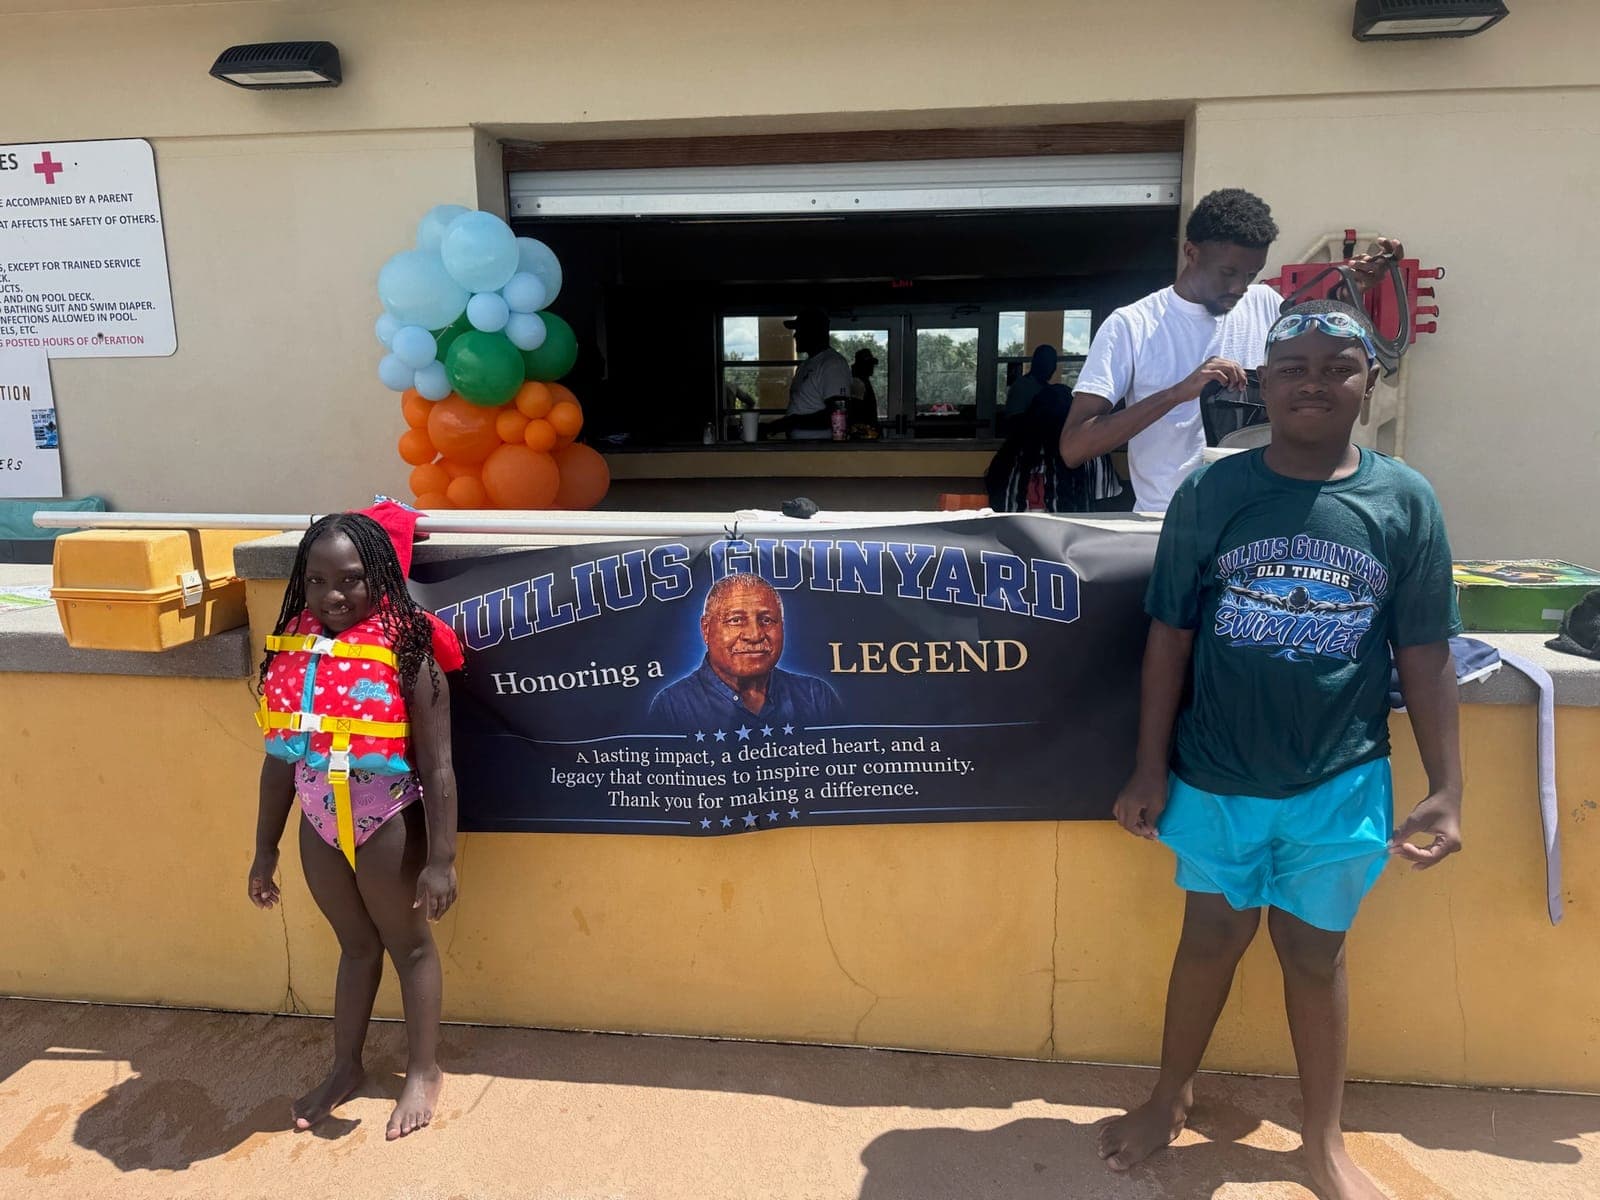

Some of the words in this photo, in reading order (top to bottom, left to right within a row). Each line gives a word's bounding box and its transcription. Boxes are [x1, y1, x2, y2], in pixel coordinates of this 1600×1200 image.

[0, 153, 18, 170] ES
[6, 195, 73, 207] ACCOMPANIED
[75, 195, 86, 204] BY
[89, 195, 96, 203] A
[97, 193, 133, 203] PARENT
[11, 219, 48, 229] AFFECTS
[49, 218, 68, 227] THE
[69, 216, 102, 226] SAFETY
[104, 216, 117, 225] OF
[119, 214, 159, 224] OTHERS.
[8, 262, 39, 272] EXCEPT
[42, 261, 60, 271] FOR
[62, 260, 102, 270] TRAINED
[104, 258, 141, 269] SERVICE
[0, 273, 11, 283] K.
[4, 294, 23, 304] AND
[25, 294, 40, 303] ON
[41, 293, 67, 303] POOL
[68, 292, 95, 301] DECK.
[4, 304, 43, 314] BATHING
[45, 304, 65, 313] SUIT
[67, 303, 88, 312] AND
[89, 302, 117, 312] SWIM
[119, 301, 156, 311] DIAPER.
[51, 314, 95, 323] ALLOWED
[97, 313, 108, 322] IN
[109, 312, 138, 322] POOL.
[20, 325, 39, 335] ETC.
[5, 338, 41, 347] POSTED
[42, 337, 75, 347] HOURS
[76, 336, 90, 346] OF
[1218, 537, 1288, 578] JULIUS
[1290, 534, 1389, 597] GUINYARD
[709, 538, 1080, 624] GUINYARD
[1256, 565, 1286, 578] OLD
[1291, 565, 1351, 588] TIMERS
[492, 661, 642, 696] Honoring
[647, 660, 665, 679] a
[828, 639, 1029, 674] LEGEND
[575, 752, 590, 764] A
[594, 747, 651, 767] lasting
[654, 747, 716, 768] impact,
[721, 752, 733, 764] a
[737, 738, 827, 763] dedicated
[832, 737, 886, 755] heart,
[890, 736, 926, 753] and
[930, 740, 942, 753] a
[550, 767, 606, 789] legacy
[609, 768, 643, 786] that
[646, 770, 727, 787] continues
[732, 769, 752, 785] to
[755, 761, 821, 783] inspire
[825, 763, 858, 777] our
[862, 757, 976, 776] community.
[607, 790, 661, 808] Thank
[664, 796, 693, 812] you
[697, 792, 725, 810] for
[729, 786, 800, 808] making
[804, 787, 816, 800] a
[820, 780, 920, 799] difference.
